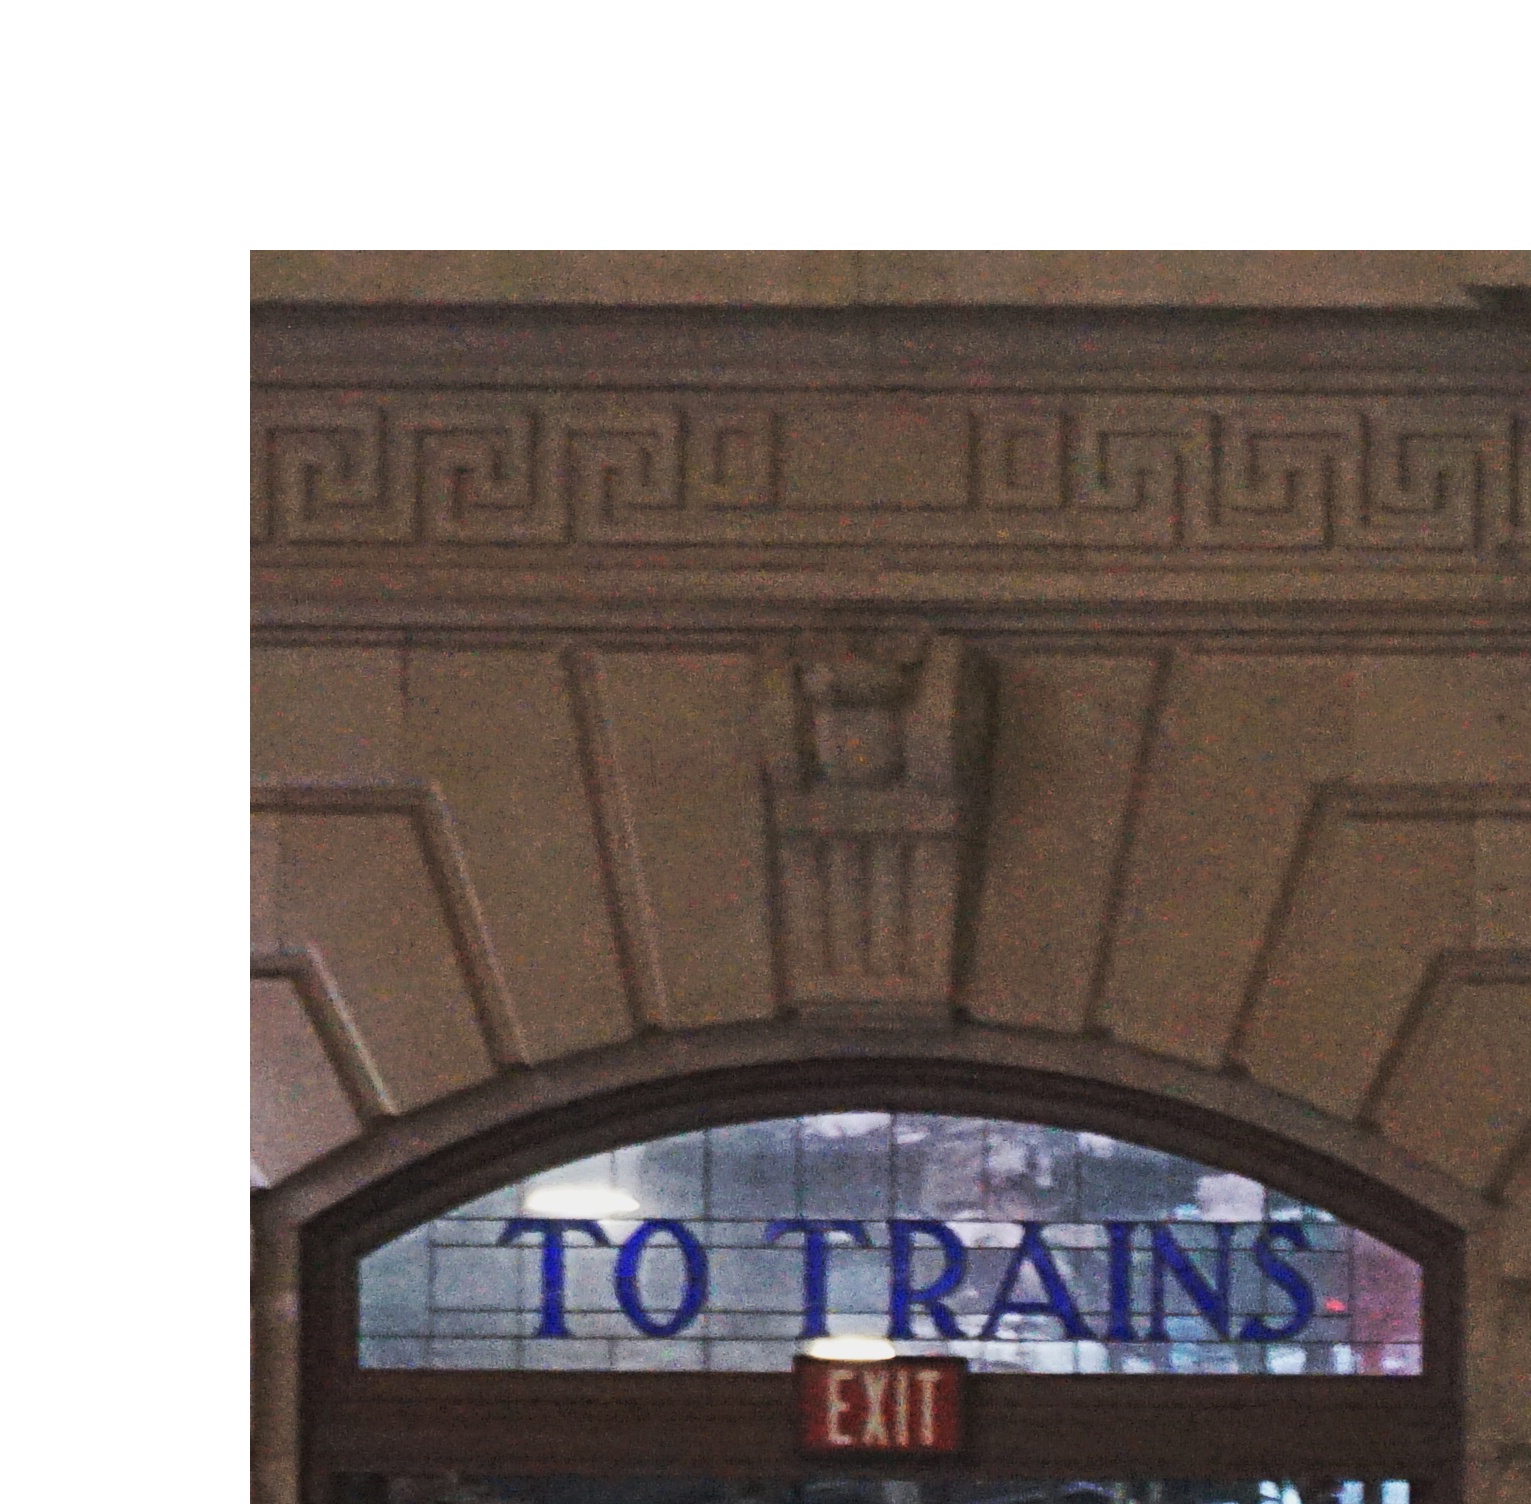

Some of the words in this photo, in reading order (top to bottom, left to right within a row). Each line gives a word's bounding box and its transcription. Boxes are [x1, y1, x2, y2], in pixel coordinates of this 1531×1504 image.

[496, 1215, 710, 1341] TO
[764, 1215, 1317, 1344] TRAINS
[826, 1370, 945, 1448] EXIT
